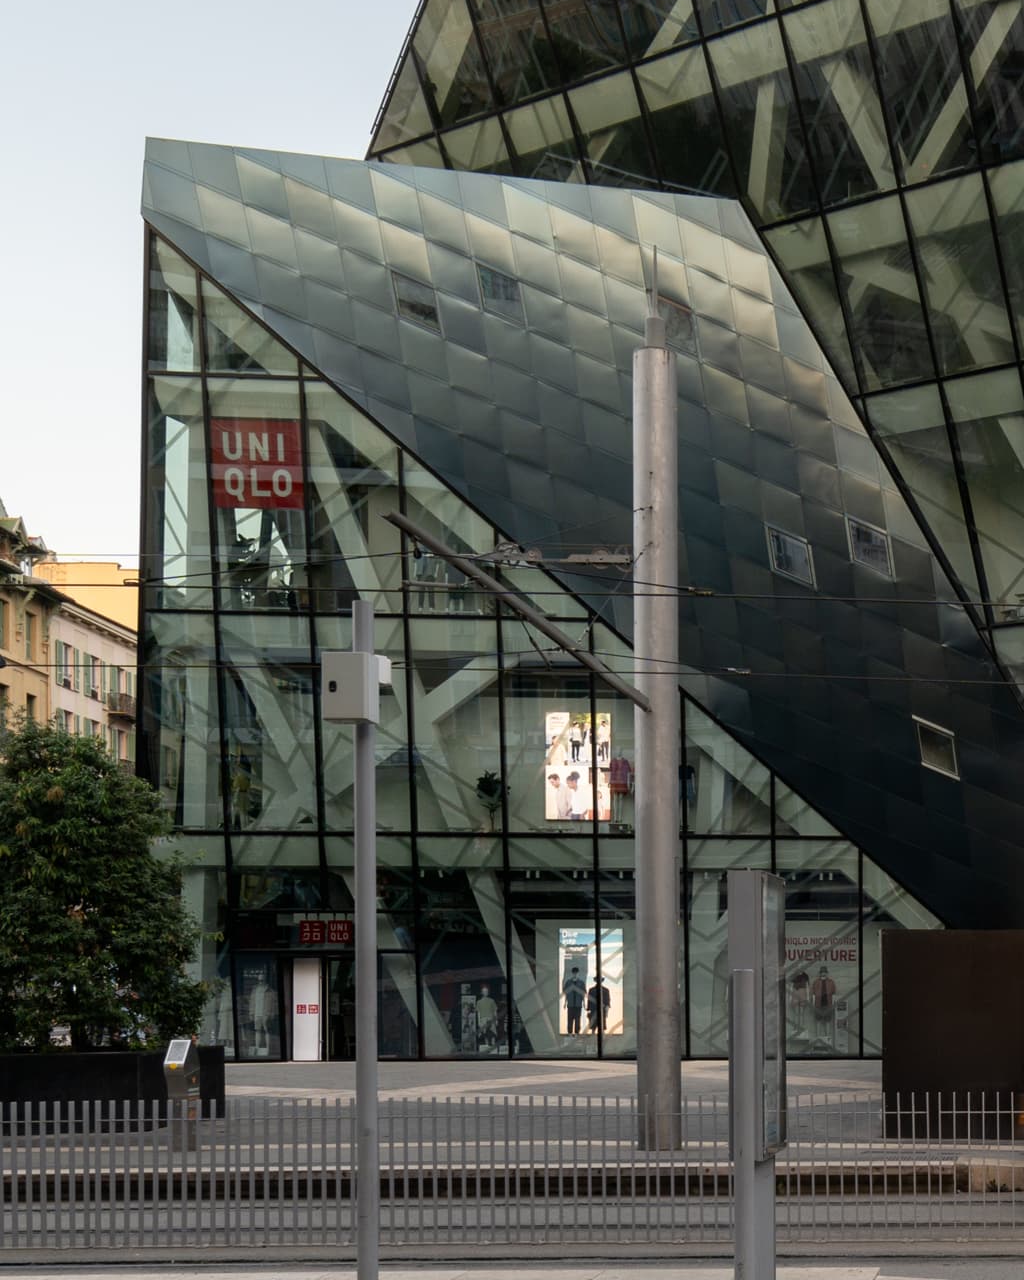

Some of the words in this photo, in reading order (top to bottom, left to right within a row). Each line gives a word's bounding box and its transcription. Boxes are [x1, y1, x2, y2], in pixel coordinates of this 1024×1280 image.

[222, 431, 285, 462] UNI
[224, 467, 292, 502] QLO
[330, 923, 348, 931] UNI
[330, 932, 349, 941] QLO
[784, 937, 809, 946] NIQLO
